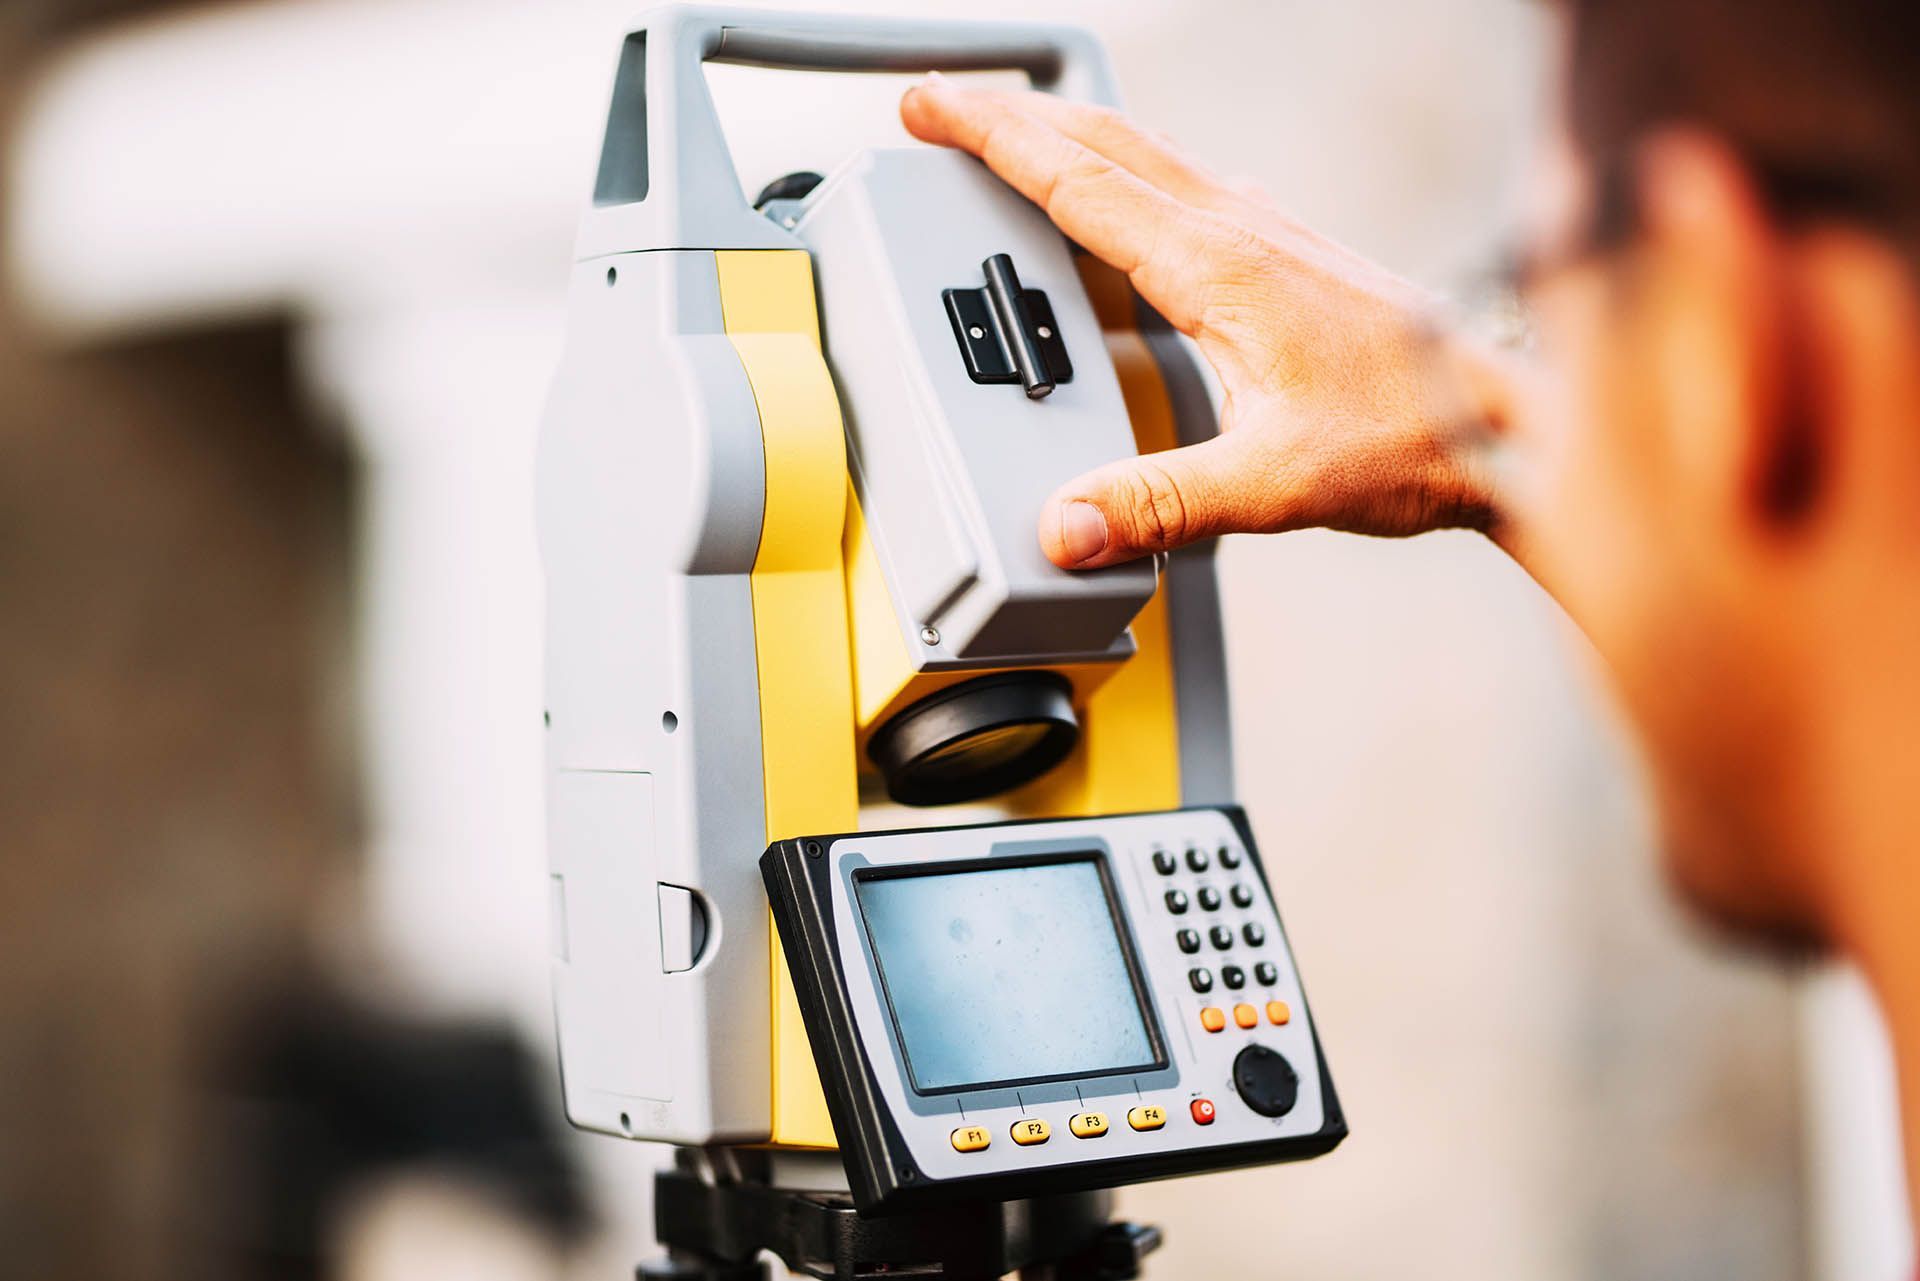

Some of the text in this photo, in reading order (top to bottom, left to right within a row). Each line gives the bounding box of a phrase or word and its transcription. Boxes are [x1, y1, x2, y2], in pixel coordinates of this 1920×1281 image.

[1145, 1110, 1159, 1121] F4
[1086, 1116, 1100, 1128] F3
[1028, 1123, 1043, 1136] F2
[968, 1131, 982, 1143] F1
